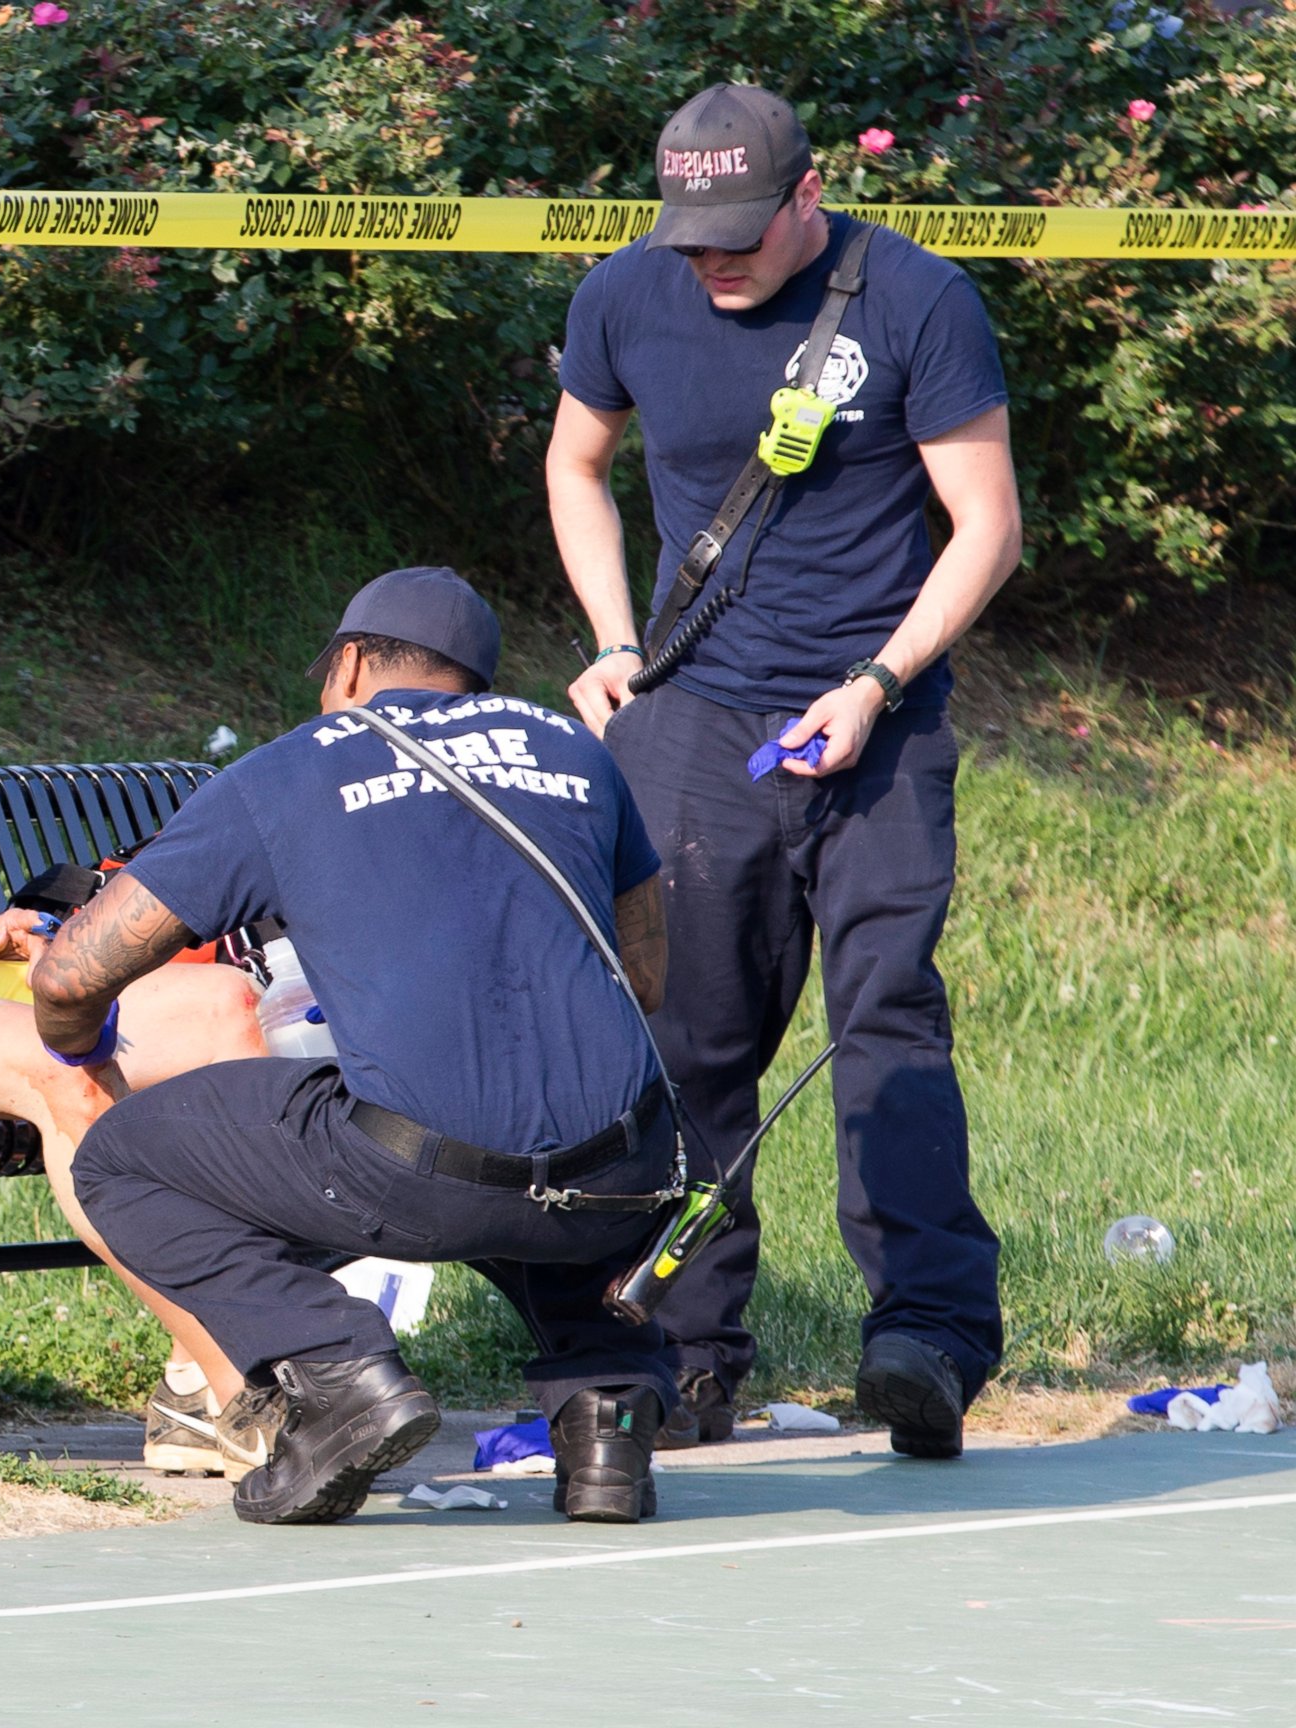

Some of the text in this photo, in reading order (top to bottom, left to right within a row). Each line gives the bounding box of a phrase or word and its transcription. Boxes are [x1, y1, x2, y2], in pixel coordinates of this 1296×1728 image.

[685, 178, 712, 192] AFD
[24, 196, 50, 234] DO
[49, 197, 104, 235] SCENE
[103, 198, 159, 236] CRIME
[240, 199, 461, 240] CRIME SCENE DO NOT CROSS
[541, 204, 655, 242] DO NOT CROSS
[920, 211, 945, 246] DO
[942, 211, 995, 246] SCENE
[993, 212, 1046, 248] CRIME
[1119, 213, 1172, 247] CROSS
[1169, 214, 1205, 248] NOT
[1203, 214, 1228, 248] DO
[1225, 215, 1277, 249] SCENE
[313, 698, 575, 747] ALXANDRIA
